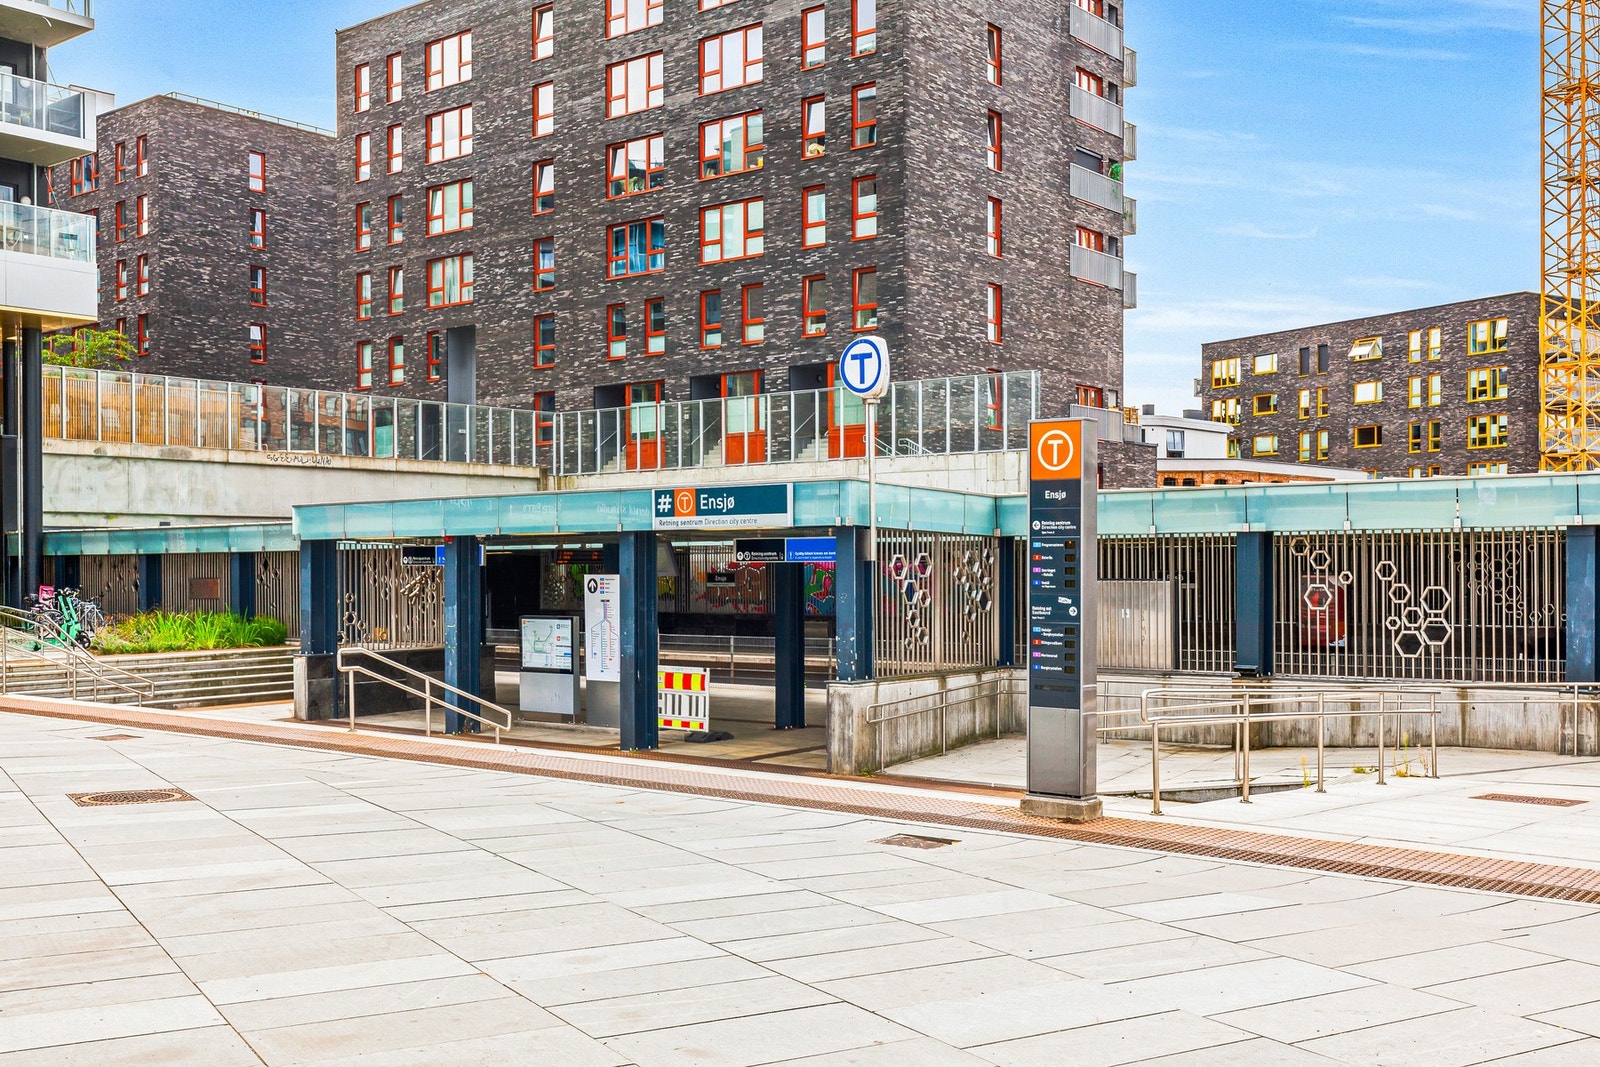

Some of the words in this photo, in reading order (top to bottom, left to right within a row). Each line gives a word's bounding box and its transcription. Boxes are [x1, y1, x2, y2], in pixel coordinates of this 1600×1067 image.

[850, 352, 873, 385] T
[1047, 439, 1063, 465] T
[700, 493, 735, 512] Ensjø
[1045, 490, 1066, 501] Ensjø
[658, 519, 680, 527] Retning
[704, 518, 729, 526] Direction
[729, 518, 739, 526] city
[739, 517, 758, 525] centre
